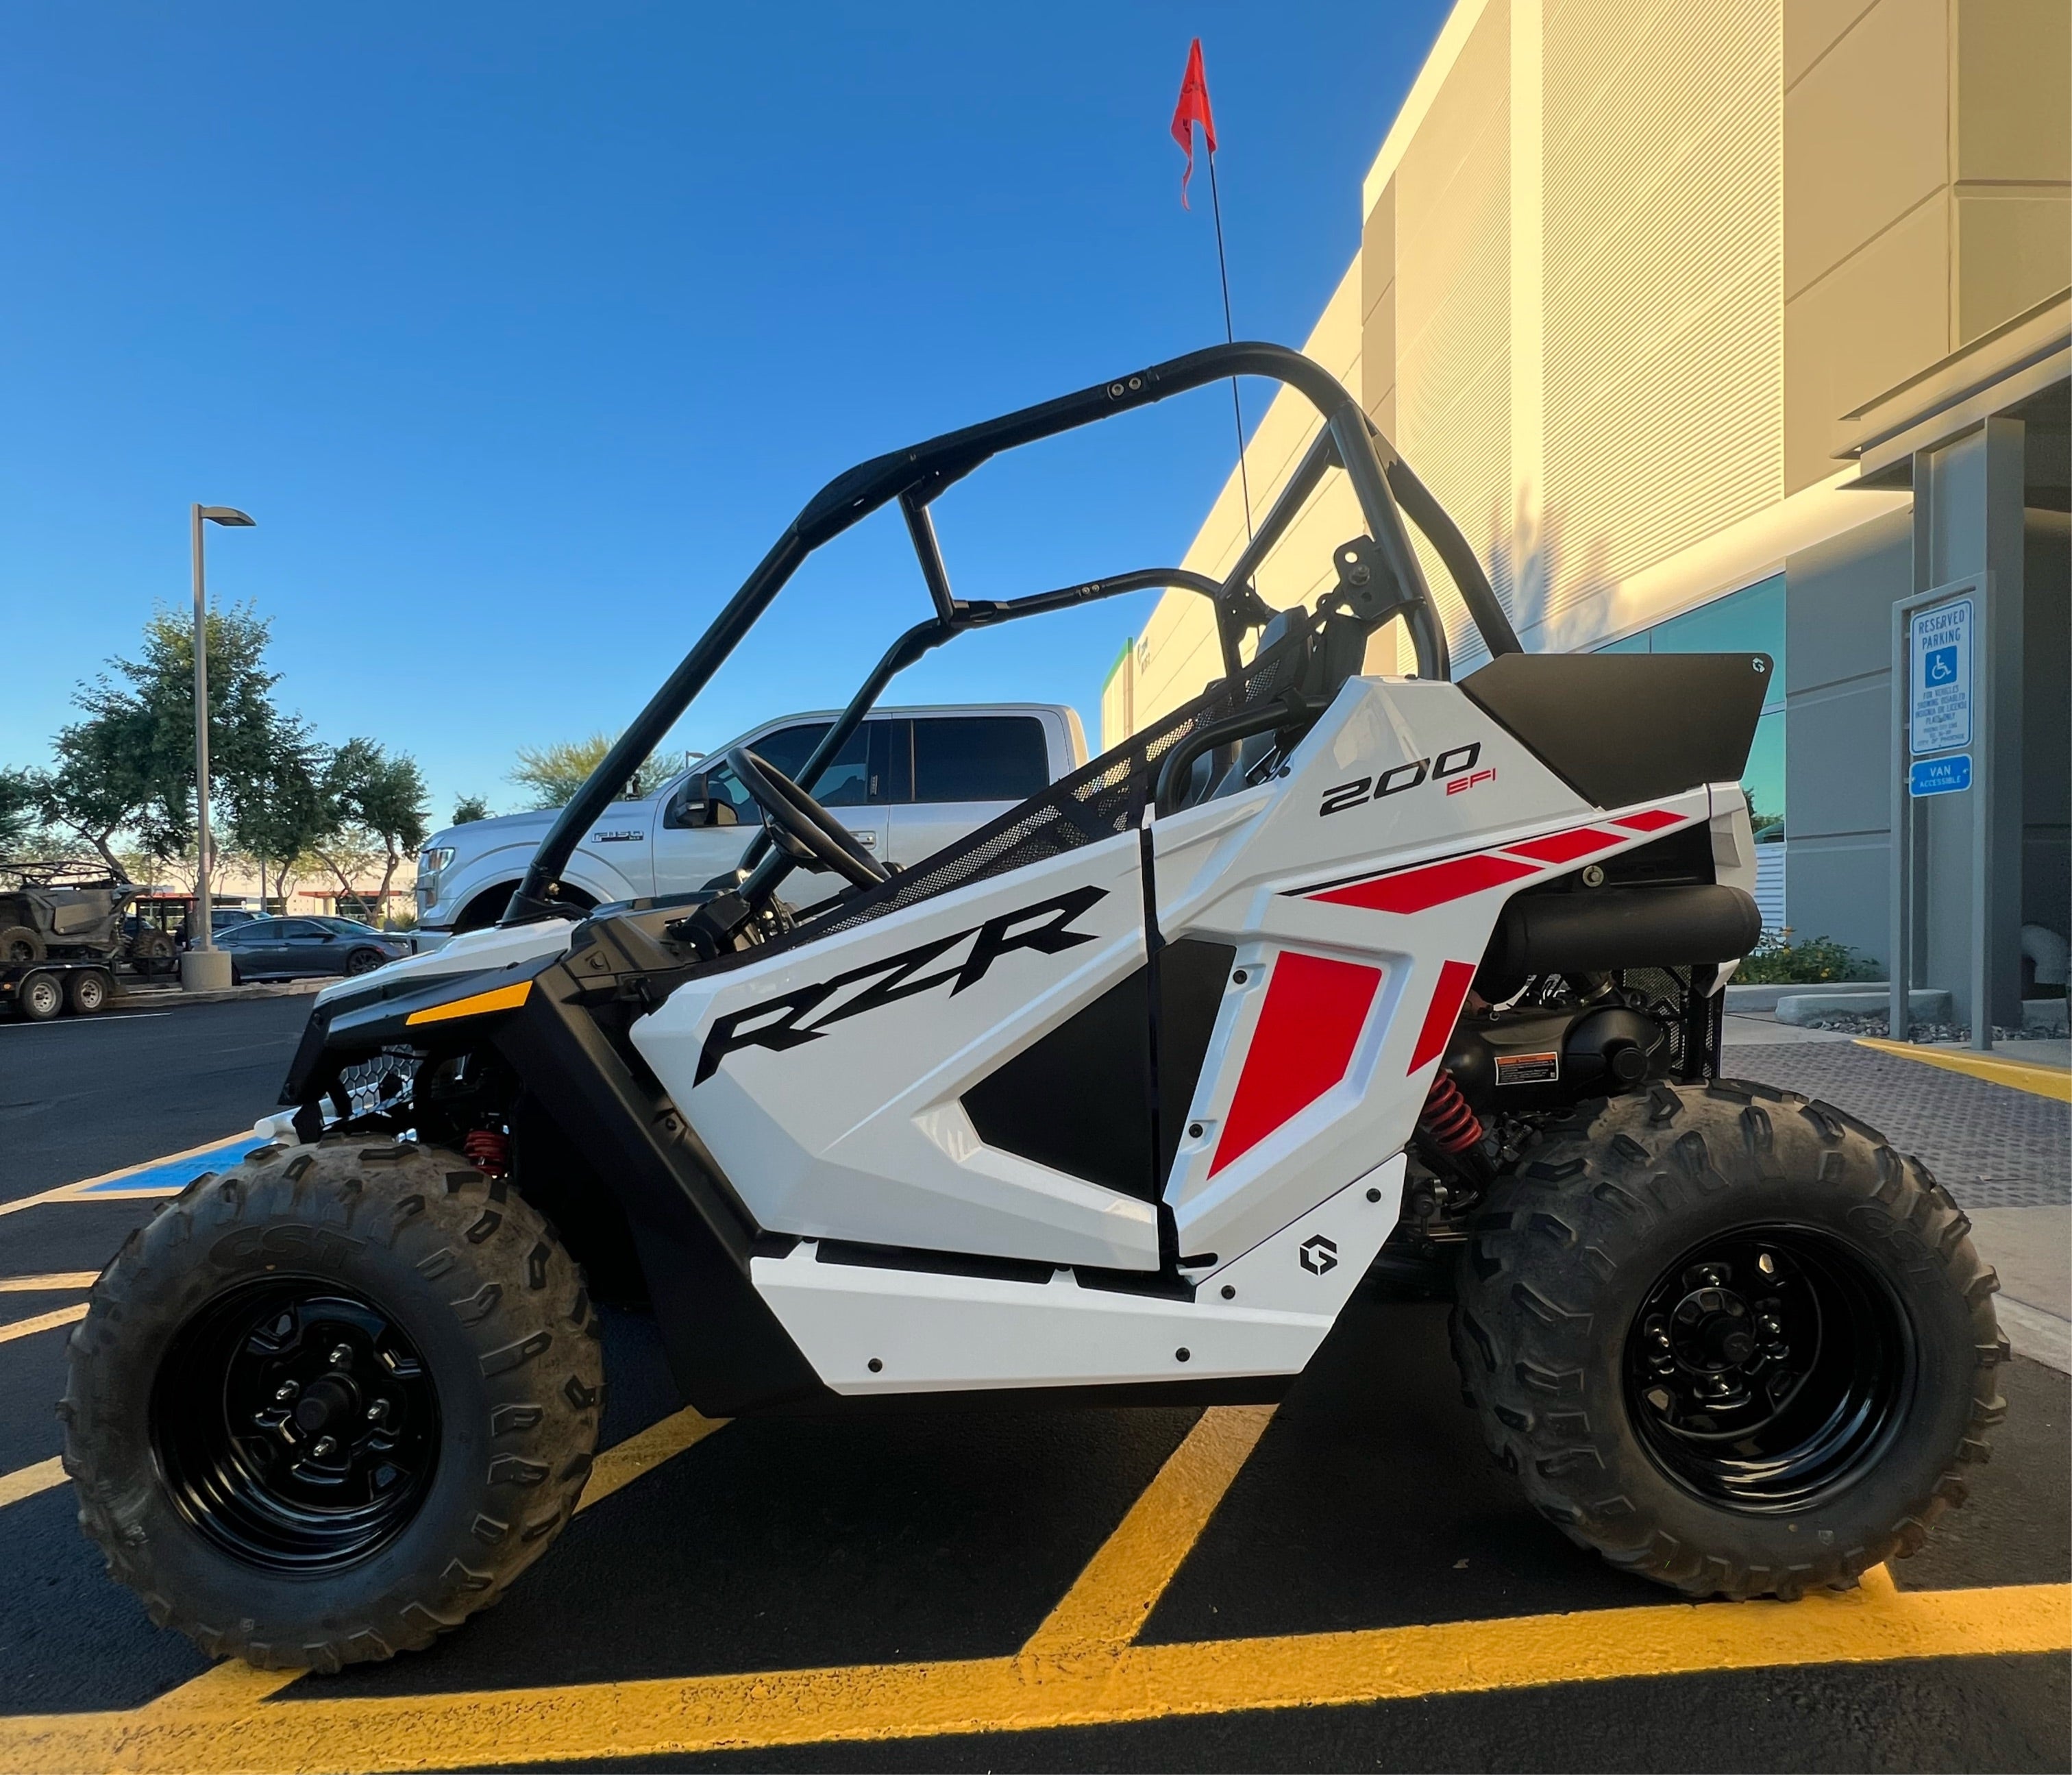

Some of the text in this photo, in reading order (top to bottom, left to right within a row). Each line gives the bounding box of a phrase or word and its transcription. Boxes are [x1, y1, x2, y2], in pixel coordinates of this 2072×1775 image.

[1919, 609, 1964, 634] RESERVED
[1922, 627, 1961, 650] PARKING
[1916, 692, 1966, 709] SHOWING DISABLED
[1923, 685, 1959, 700] FOR VEHICLES
[1915, 707, 1936, 719] INSIGNIA
[1937, 705, 1945, 714] OR
[1320, 742, 1481, 817] 200
[1446, 768, 1496, 796] EFI
[1919, 775, 1962, 788] ACCESSIBLE
[1929, 765, 1951, 777] VAN
[692, 885, 1111, 1089] RZR
[208, 1223, 368, 1270] CST
